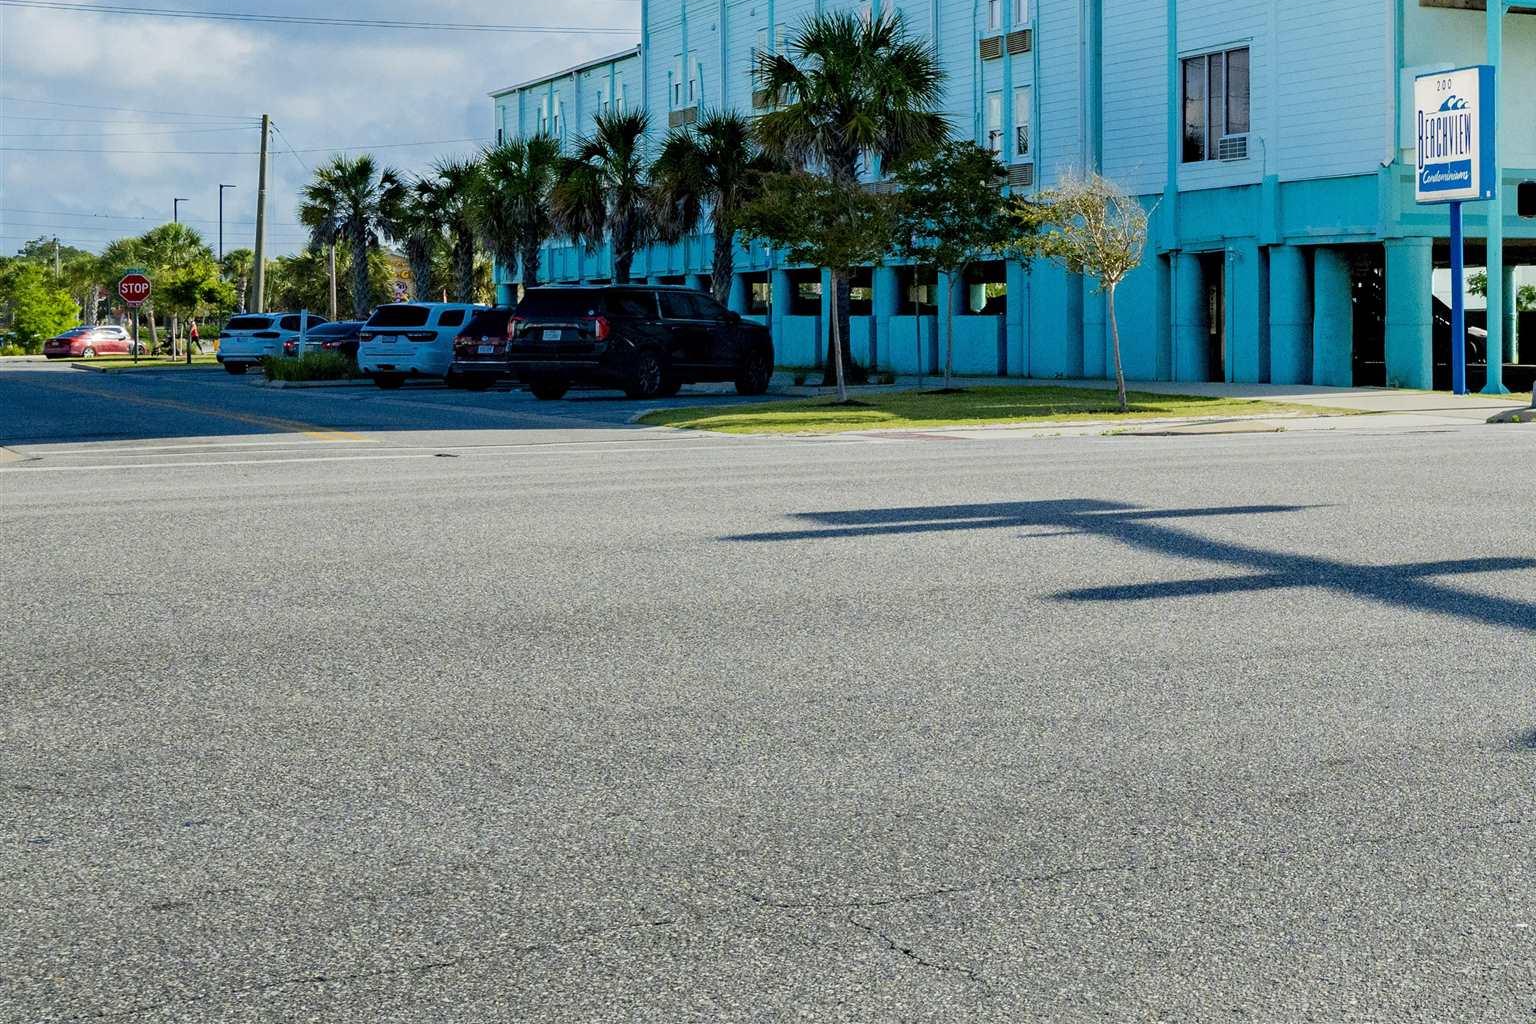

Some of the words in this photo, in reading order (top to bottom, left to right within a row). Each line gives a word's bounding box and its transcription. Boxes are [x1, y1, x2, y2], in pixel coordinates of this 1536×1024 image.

[1437, 78, 1452, 91] 200
[1418, 110, 1471, 170] BEACHVIEW
[121, 282, 149, 294] STOP
